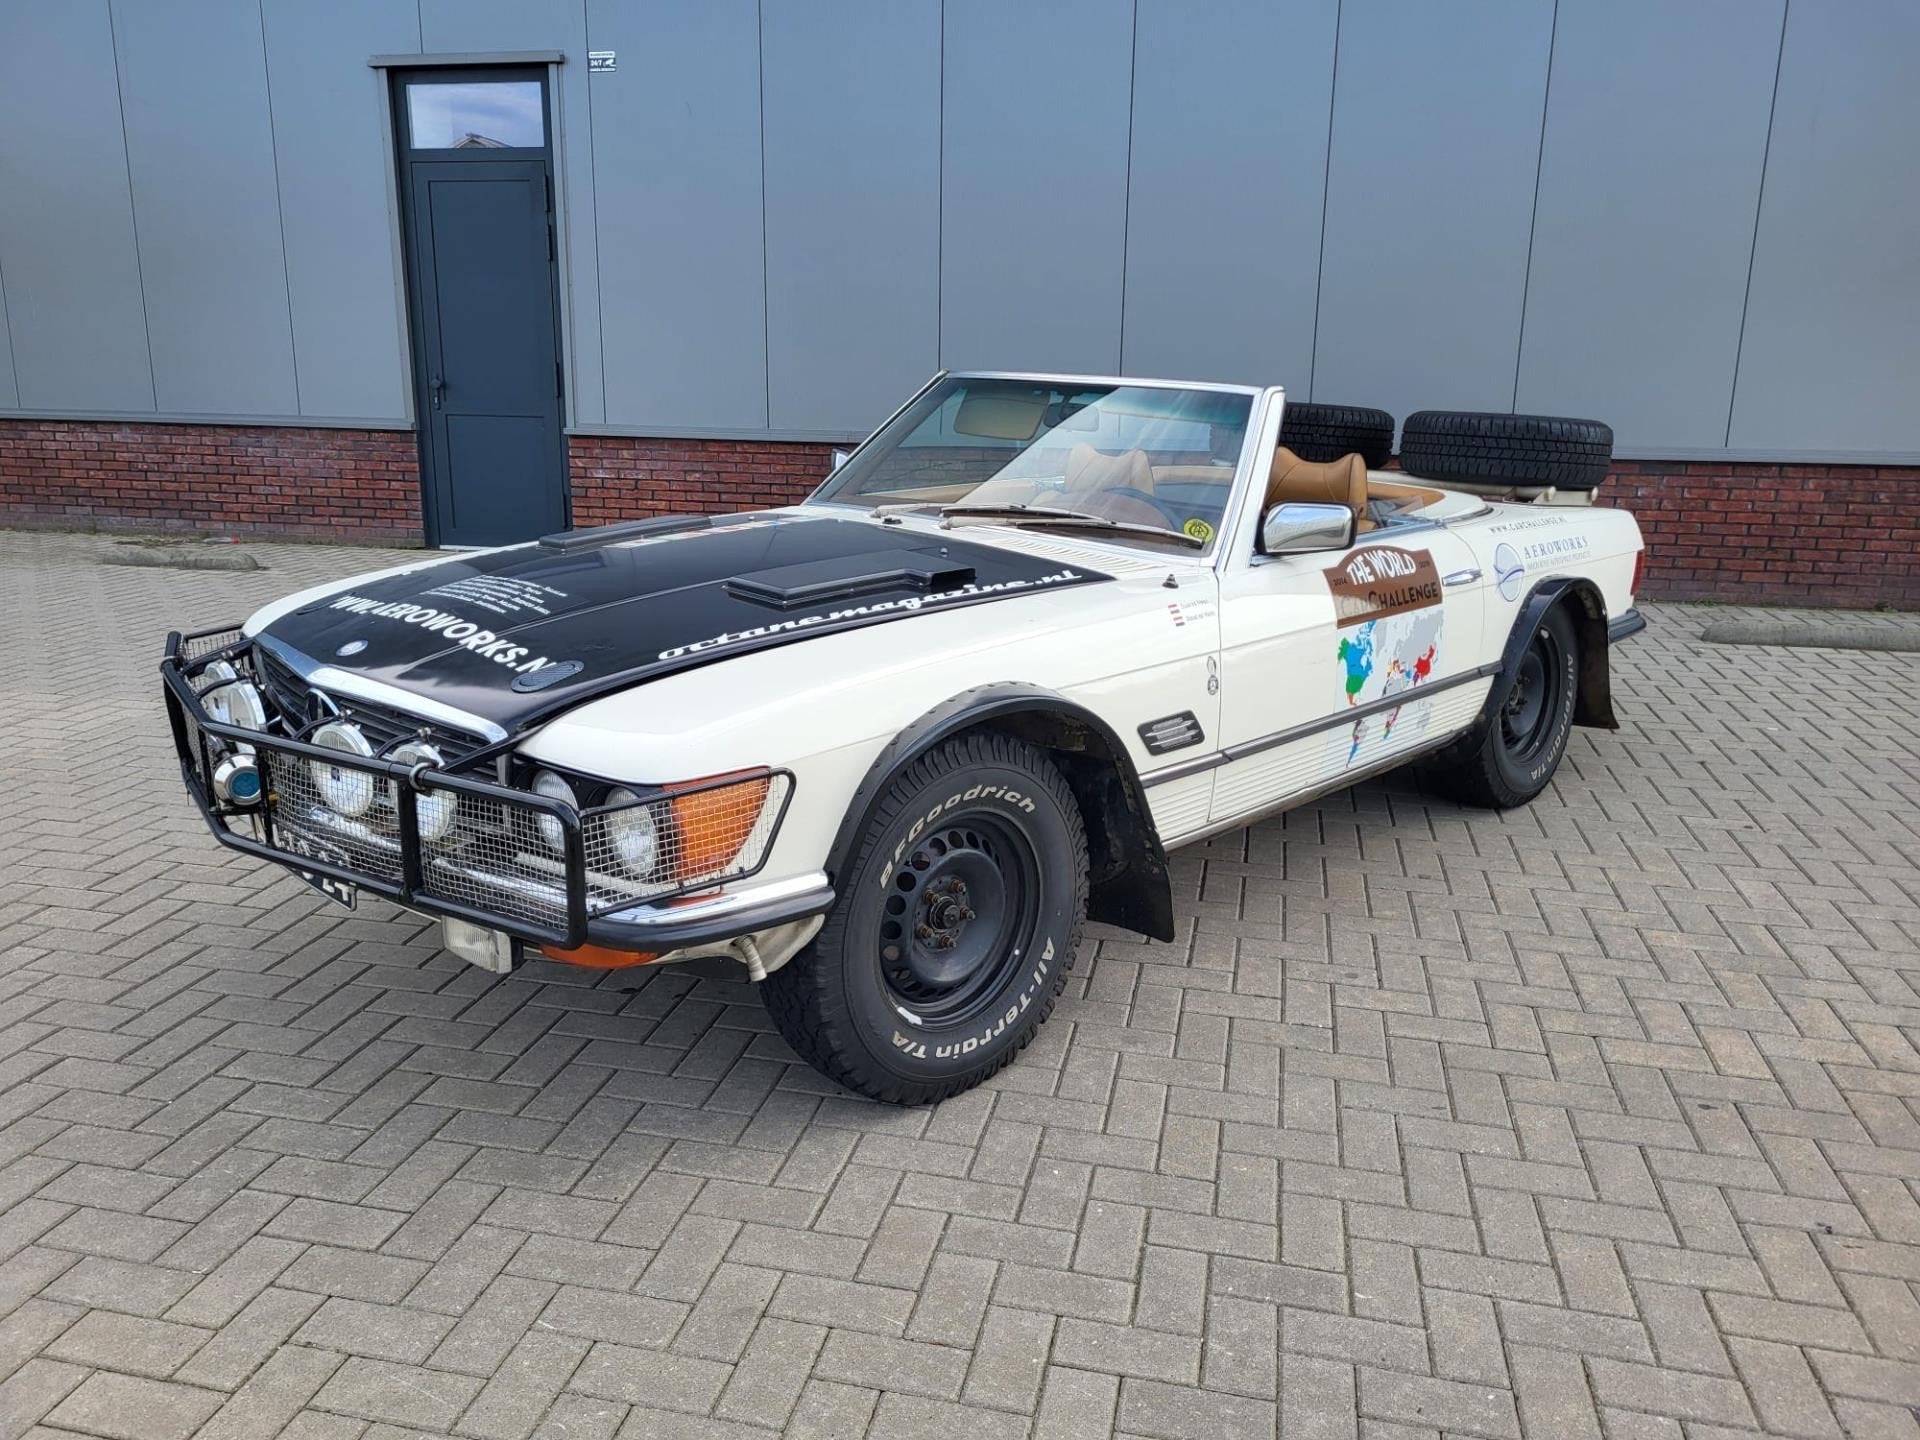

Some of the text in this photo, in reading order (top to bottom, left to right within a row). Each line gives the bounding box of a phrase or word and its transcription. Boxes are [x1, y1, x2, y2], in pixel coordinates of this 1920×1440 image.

[1346, 549, 1417, 586] THE WORLD
[1524, 535, 1589, 559] AEROWORKS
[658, 570, 1082, 660] octanemagazine.nl
[880, 784, 1036, 889] BFGoodrich
[892, 937, 1055, 1059] All-Terrain T/A
